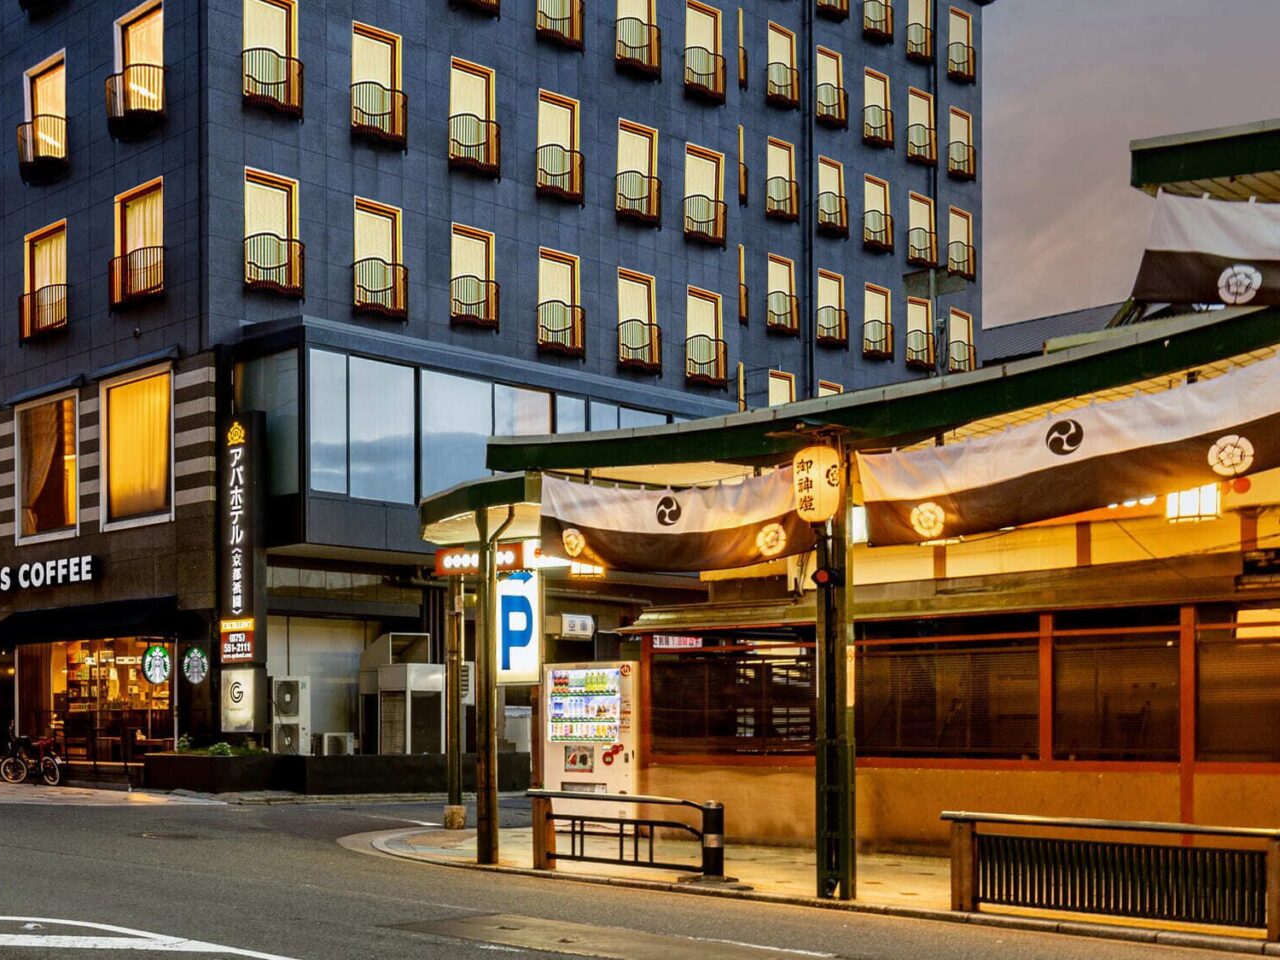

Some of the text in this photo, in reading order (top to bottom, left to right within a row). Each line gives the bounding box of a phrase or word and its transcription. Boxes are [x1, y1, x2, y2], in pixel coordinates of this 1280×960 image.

[18, 555, 92, 588] COFFEE
[223, 643, 251, 653] 551-2111
[501, 595, 533, 670] P
